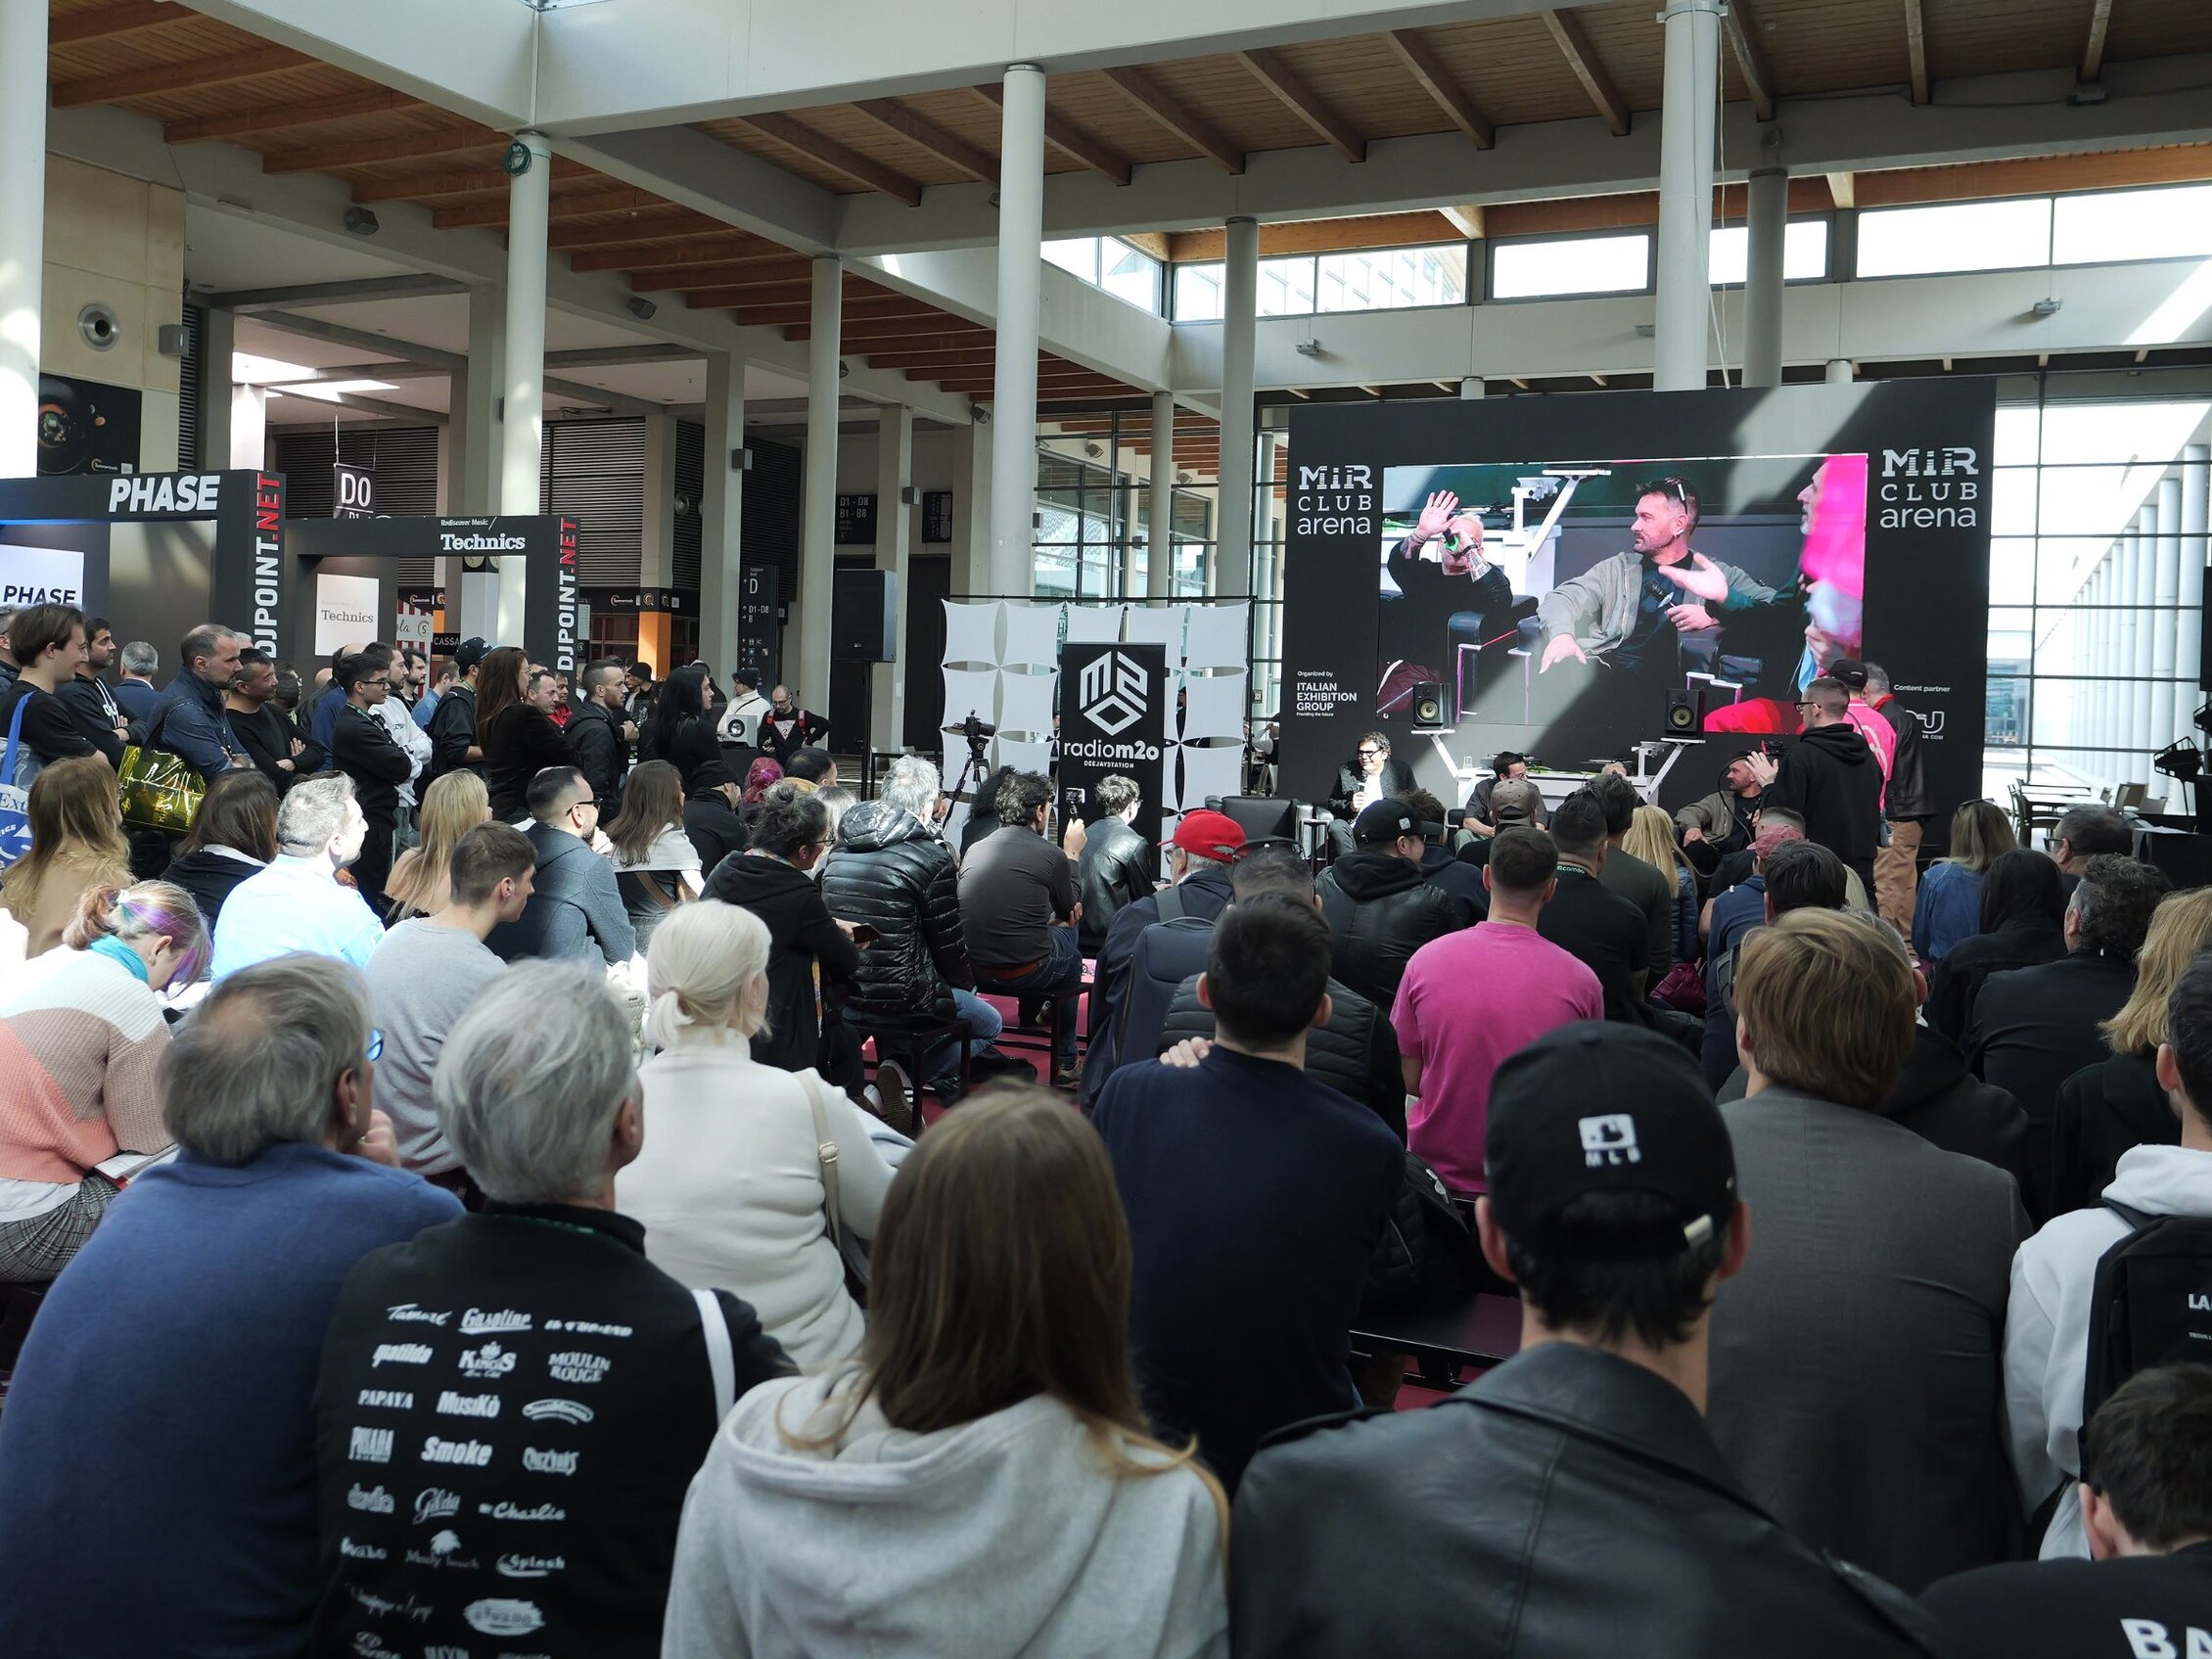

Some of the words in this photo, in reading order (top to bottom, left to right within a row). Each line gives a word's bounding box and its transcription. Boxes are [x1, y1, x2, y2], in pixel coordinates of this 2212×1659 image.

[109, 476, 220, 512] PHASE
[1880, 483, 1978, 501] CLUB
[1298, 495, 1372, 512] CLUB
[1297, 516, 1371, 535] arena
[1879, 507, 1977, 529] arena
[440, 532, 526, 550] Technics
[254, 473, 283, 659] DJPOINT.NET
[3, 585, 76, 605] PHASE
[557, 517, 576, 671] DJPOINT.NET
[749, 578, 759, 594] D
[321, 610, 374, 623] Technics
[434, 637, 460, 646] CASSA
[1297, 682, 1337, 691] ITALIAN
[1297, 692, 1358, 702] EXHIBITION
[1296, 702, 1334, 712] GROUP
[548, 1352, 611, 1371] MOULIN
[358, 1389, 413, 1409] PAPAYA
[421, 1435, 492, 1467] Smoke
